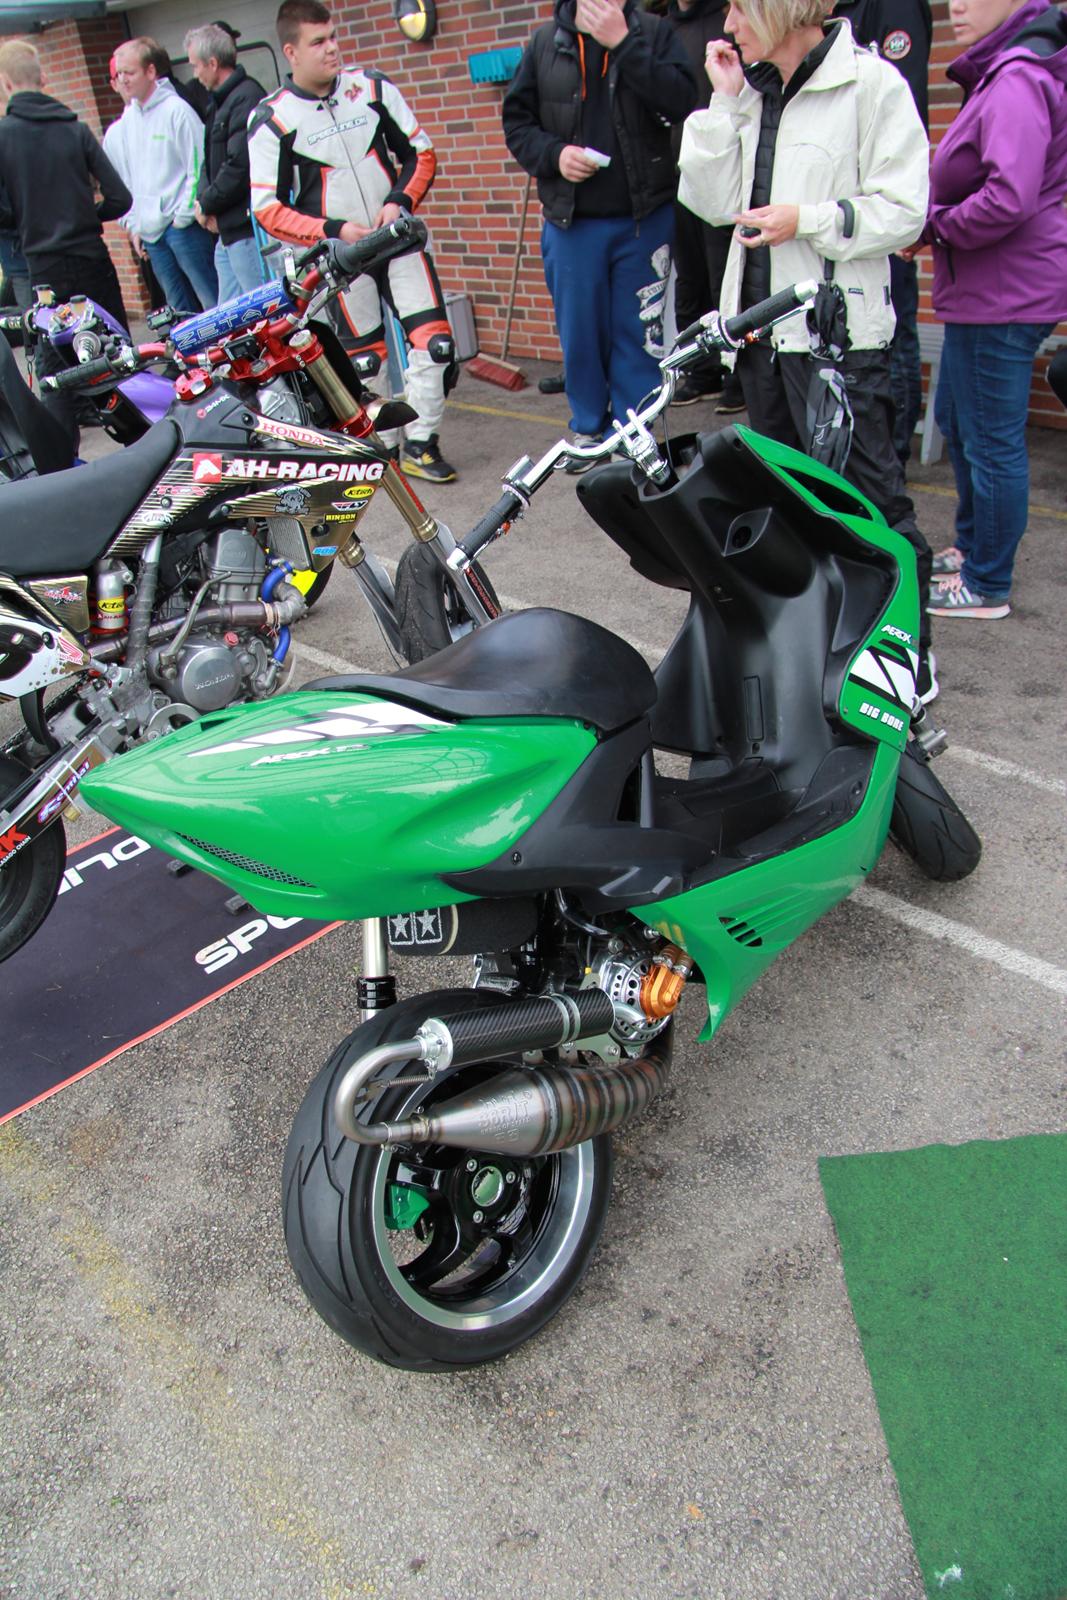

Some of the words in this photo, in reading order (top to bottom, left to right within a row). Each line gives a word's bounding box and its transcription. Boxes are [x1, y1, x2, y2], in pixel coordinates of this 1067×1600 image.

[262, 422, 325, 447] HONDA
[226, 458, 385, 481] AH-RACING
[195, 672, 235, 691] HONDA
[859, 702, 880, 719] BIG
[881, 712, 904, 732] BORE
